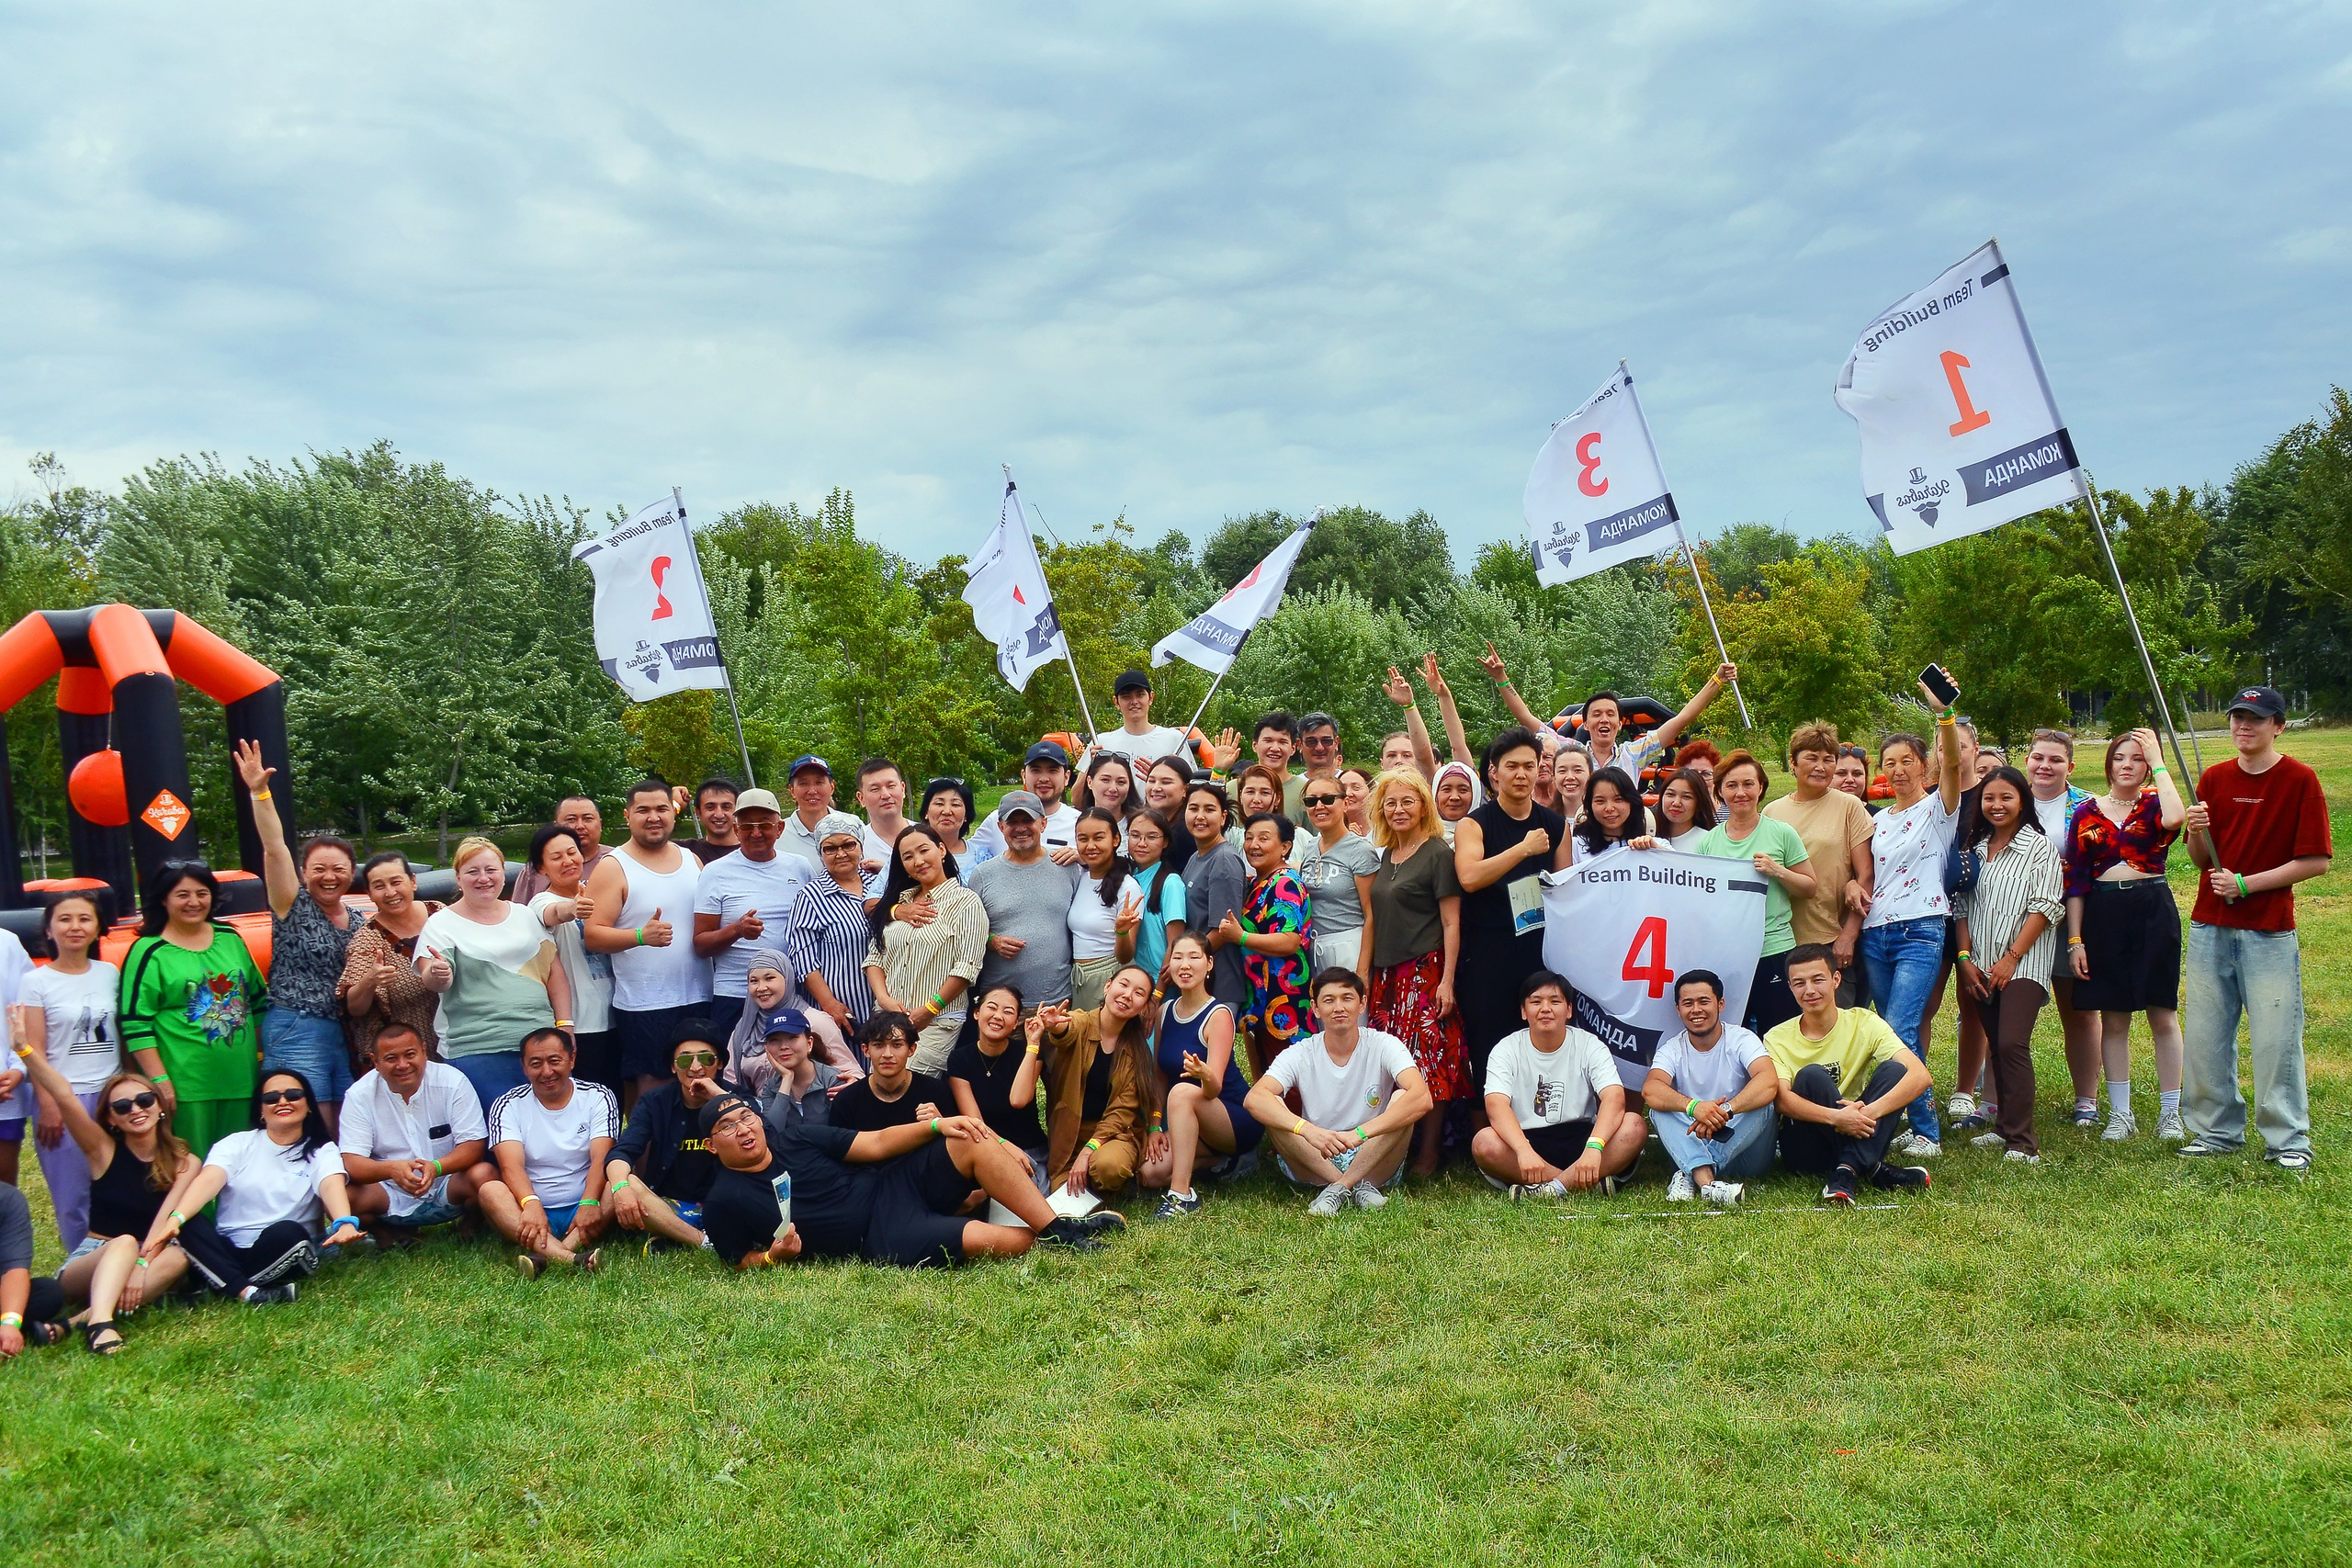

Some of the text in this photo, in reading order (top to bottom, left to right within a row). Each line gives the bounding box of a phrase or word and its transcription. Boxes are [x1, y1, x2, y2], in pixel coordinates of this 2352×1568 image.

[148, 805, 187, 818] Karabas
[1578, 865, 1716, 894] Team Building
[1622, 916, 1674, 999] 4
[774, 1016, 787, 1024] NYC
[1577, 991, 1637, 1052] ОМАНДА
